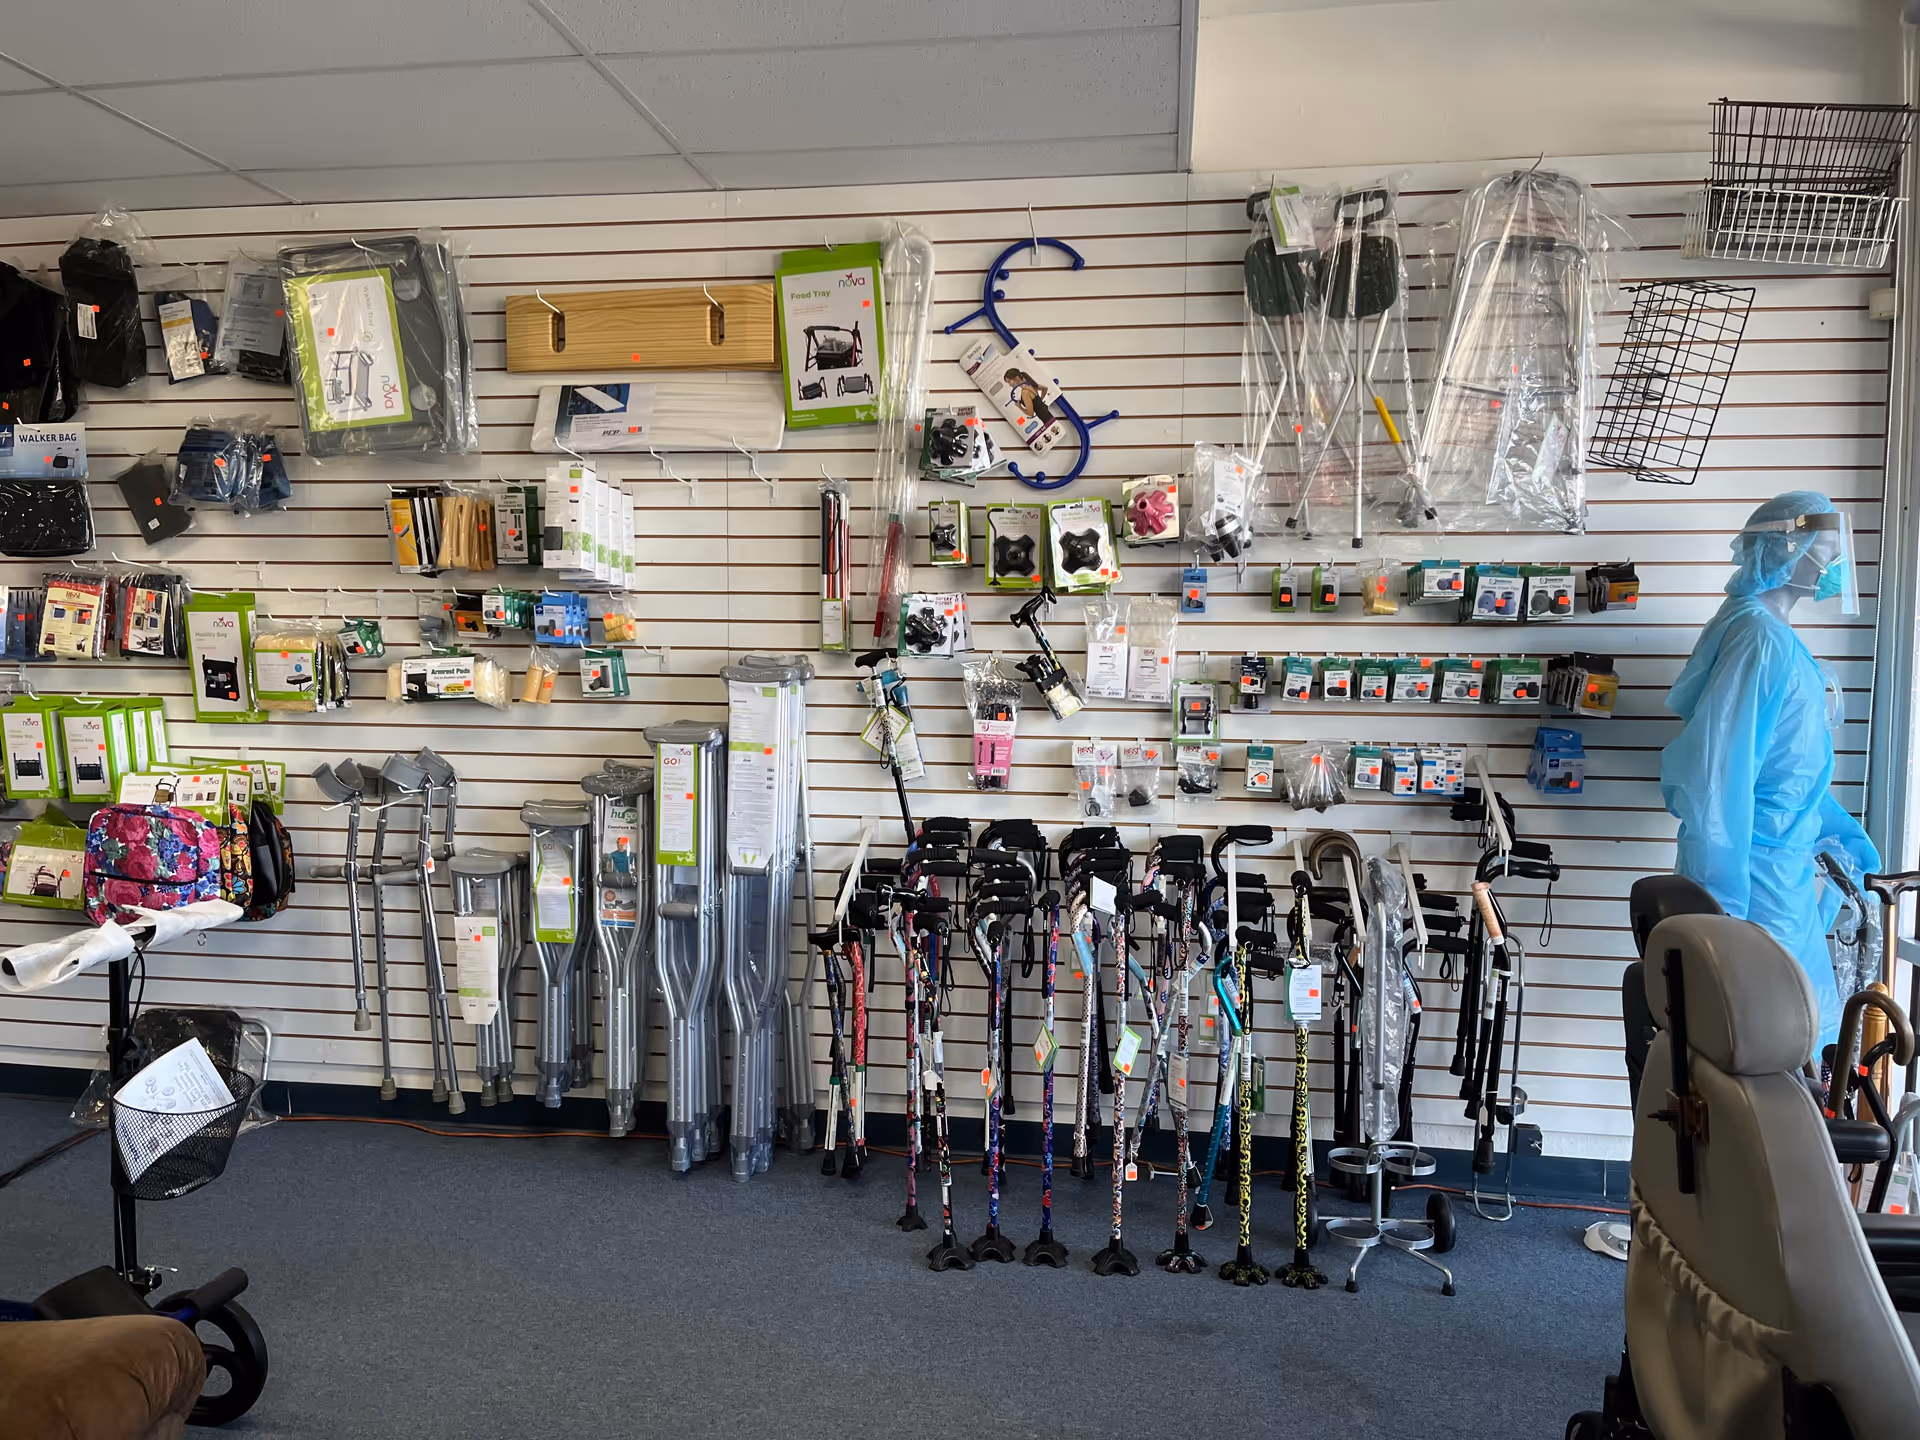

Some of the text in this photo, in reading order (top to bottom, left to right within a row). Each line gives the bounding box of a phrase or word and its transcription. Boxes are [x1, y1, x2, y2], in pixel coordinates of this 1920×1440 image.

[839, 277, 865, 287] nova
[791, 290, 831, 300] Food Tray
[380, 374, 394, 409] nova
[19, 433, 77, 442] WALKER BAG
[213, 619, 234, 628] nova
[664, 757, 681, 765] GO!
[611, 808, 637, 823] hugo
